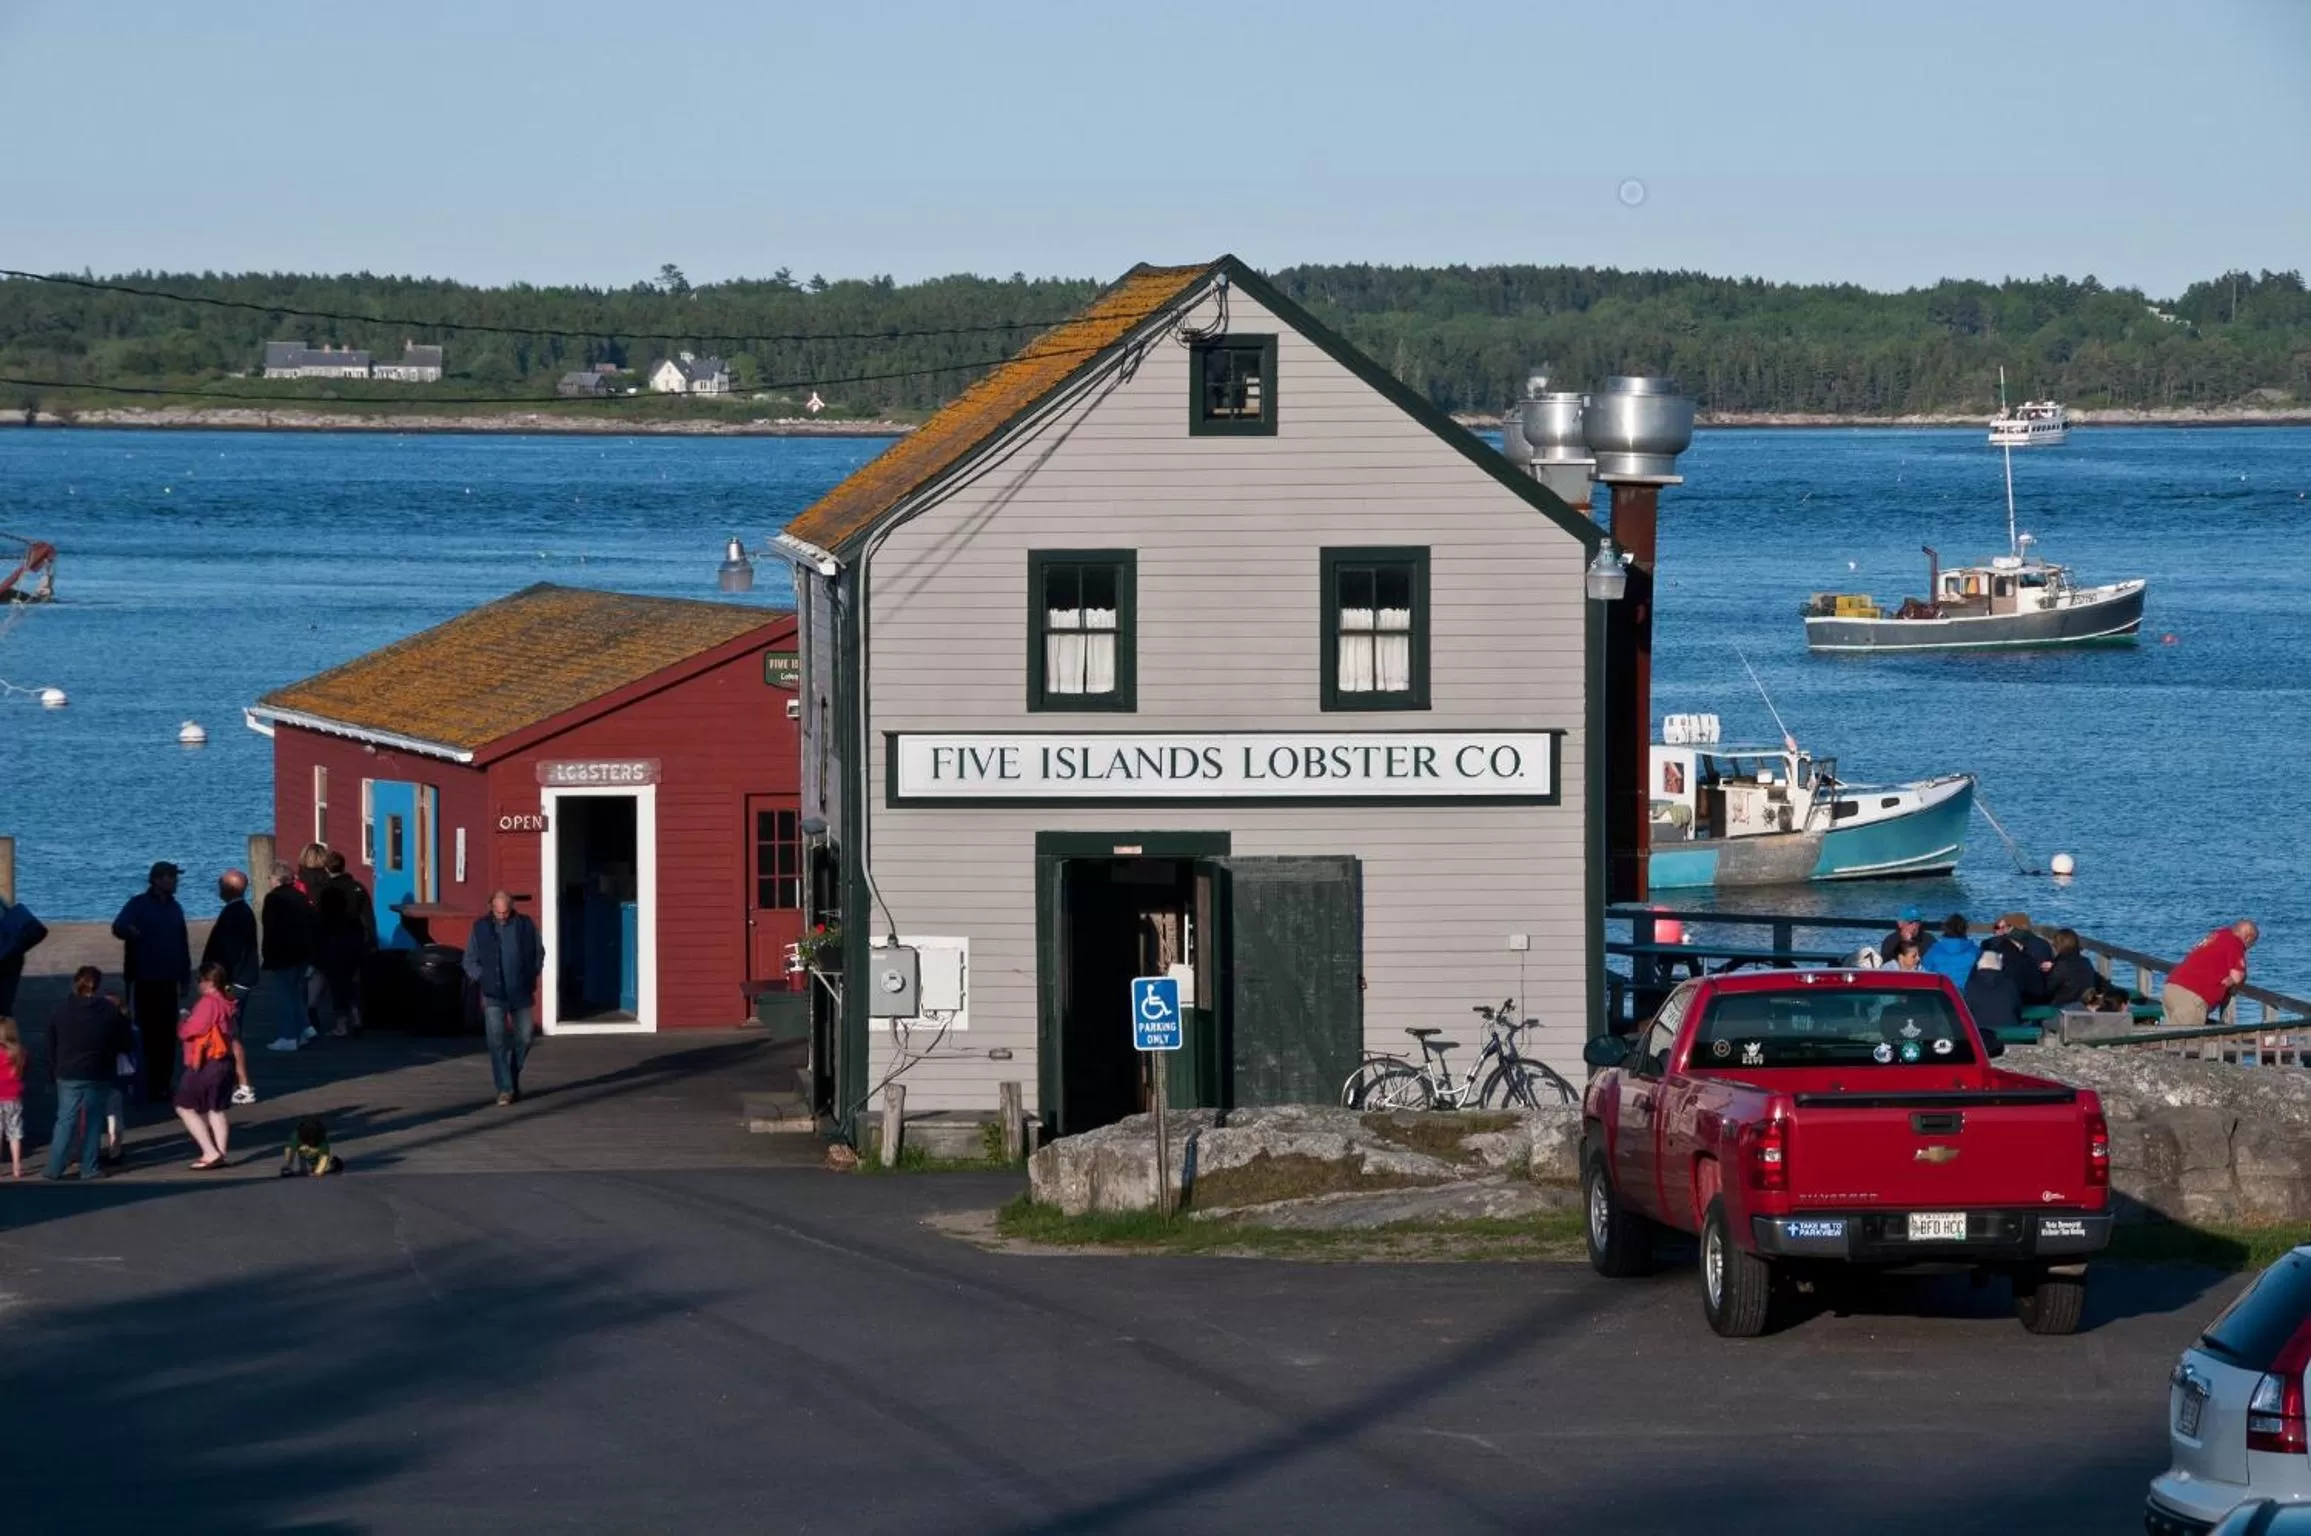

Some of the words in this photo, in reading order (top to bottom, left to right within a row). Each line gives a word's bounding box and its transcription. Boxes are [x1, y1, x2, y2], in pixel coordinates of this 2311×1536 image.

[931, 746, 1022, 779] FIVE
[1041, 745, 1224, 779] ISLANDS
[1243, 745, 1441, 779] LOBSTER
[1455, 744, 1526, 779] CO.
[557, 763, 645, 781] LOBSTERS
[499, 815, 543, 831] OPEN
[1138, 1022, 1177, 1033] PARKING
[1147, 1034, 1169, 1044] ONLY
